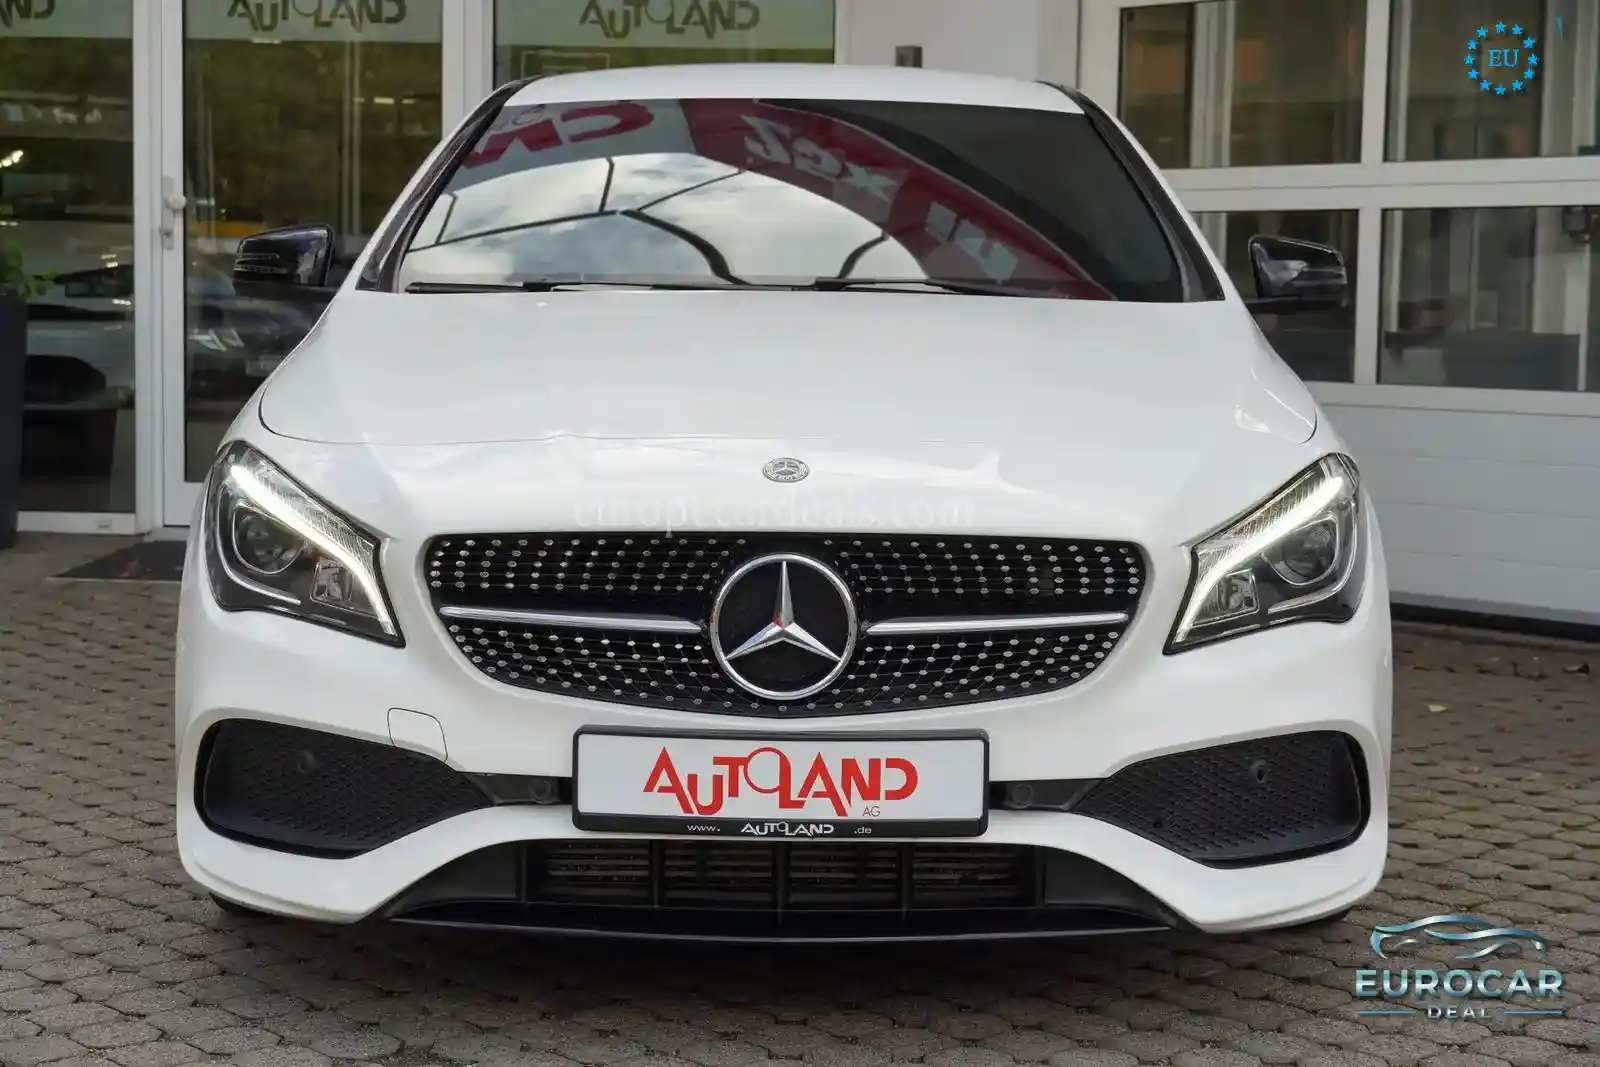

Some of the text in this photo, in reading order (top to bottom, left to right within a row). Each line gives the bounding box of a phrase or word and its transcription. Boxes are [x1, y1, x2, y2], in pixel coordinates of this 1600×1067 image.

[0, 0, 56, 29] ND
[579, 0, 760, 40] AUTOLAND
[643, 746, 919, 817] AUTOLAND
[862, 805, 881, 817] AG
[686, 821, 872, 836] www. AUTOLAND .de
